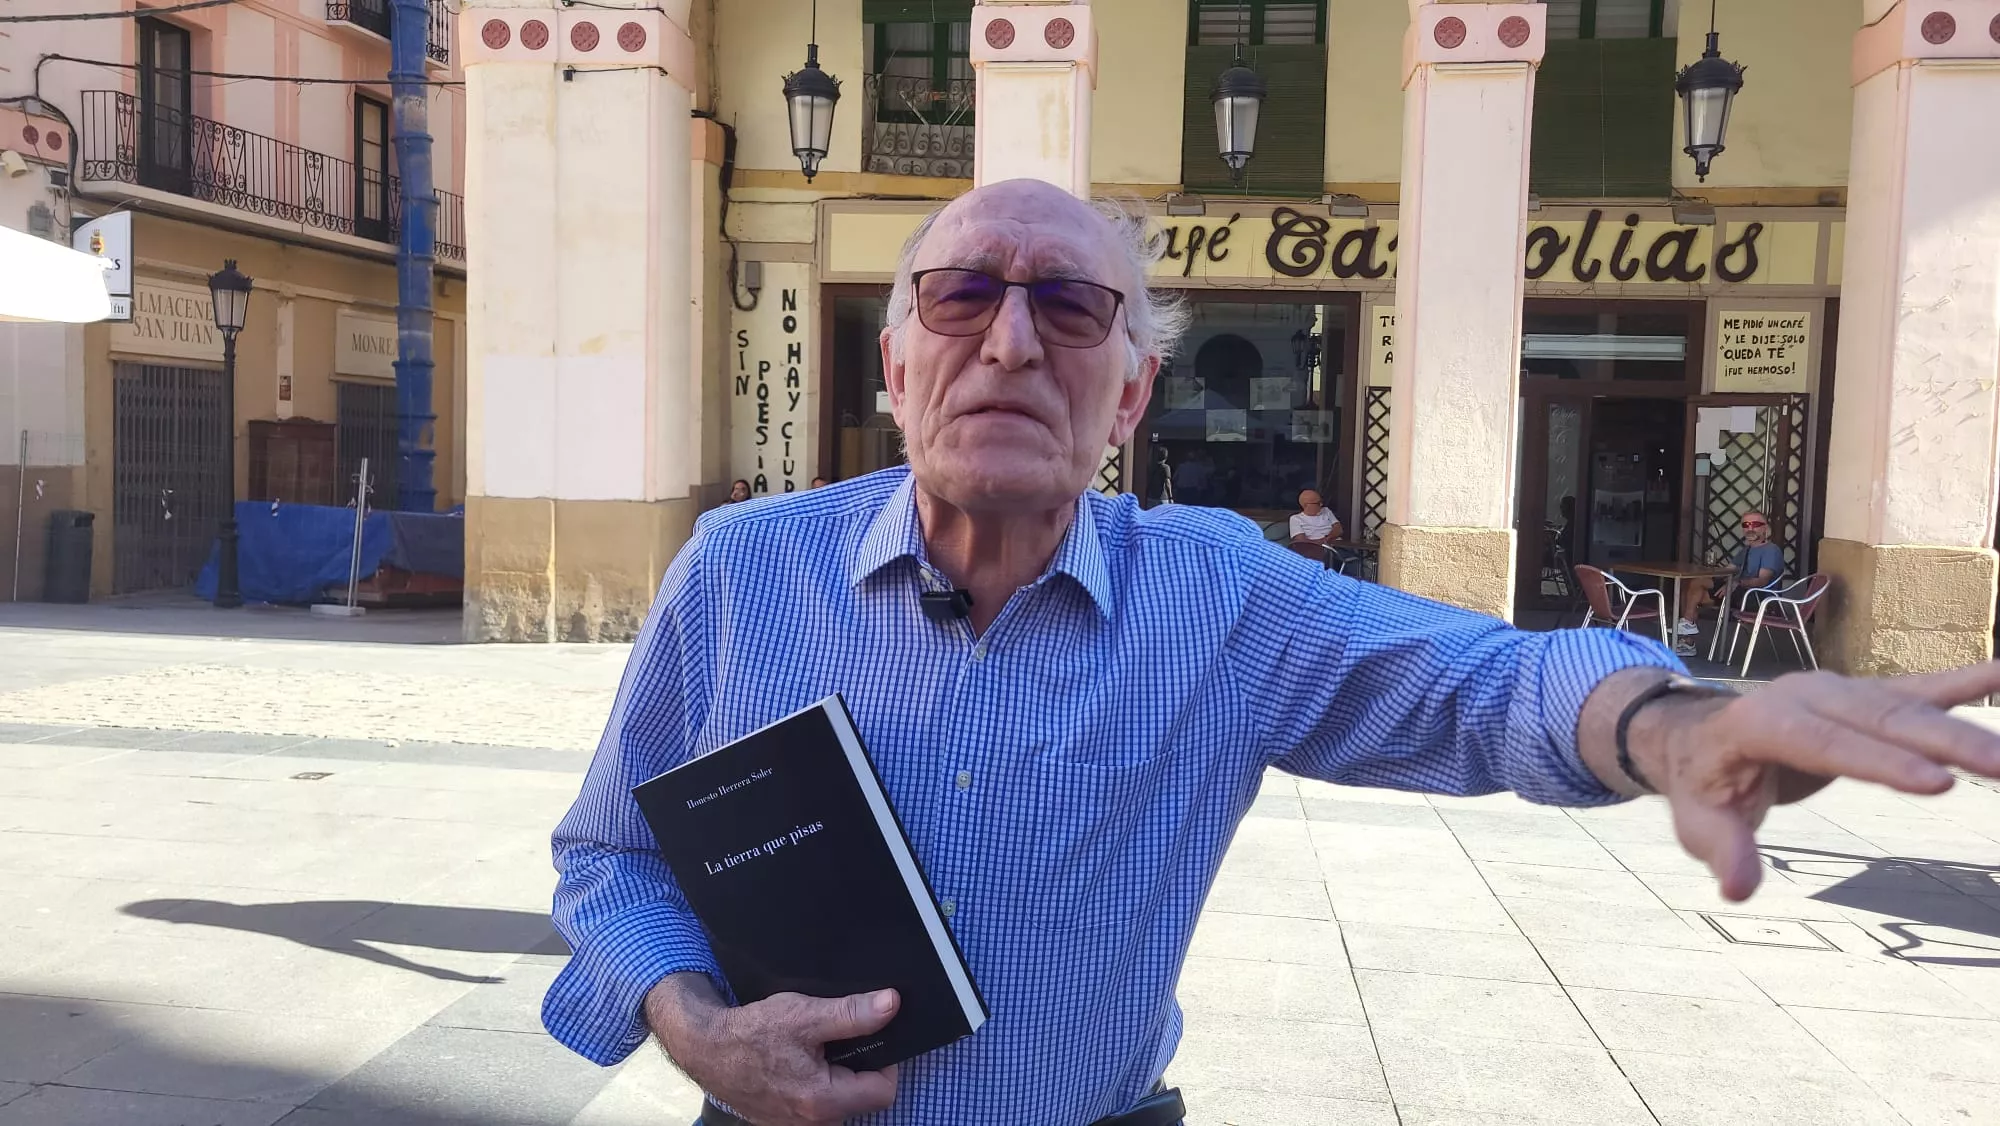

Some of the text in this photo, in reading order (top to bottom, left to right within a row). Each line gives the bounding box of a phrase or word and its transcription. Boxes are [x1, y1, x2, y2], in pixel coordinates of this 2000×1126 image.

[133, 315, 213, 345] SAN JUAN
[1723, 318, 1740, 329] ME
[1743, 316, 1764, 329] PIDIÓ
[1779, 315, 1805, 329] CAFÉ
[351, 332, 394, 357] MONRE
[1723, 333, 1731, 345] Y
[1735, 334, 1746, 344] LE
[735, 329, 750, 396] SIN
[1747, 361, 1796, 375] HERMOSO!
[781, 288, 801, 493] NO HAY CIUD
[686, 767, 773, 809] Honesto Herrera Soler
[704, 820, 824, 875] La tierra que pisas
